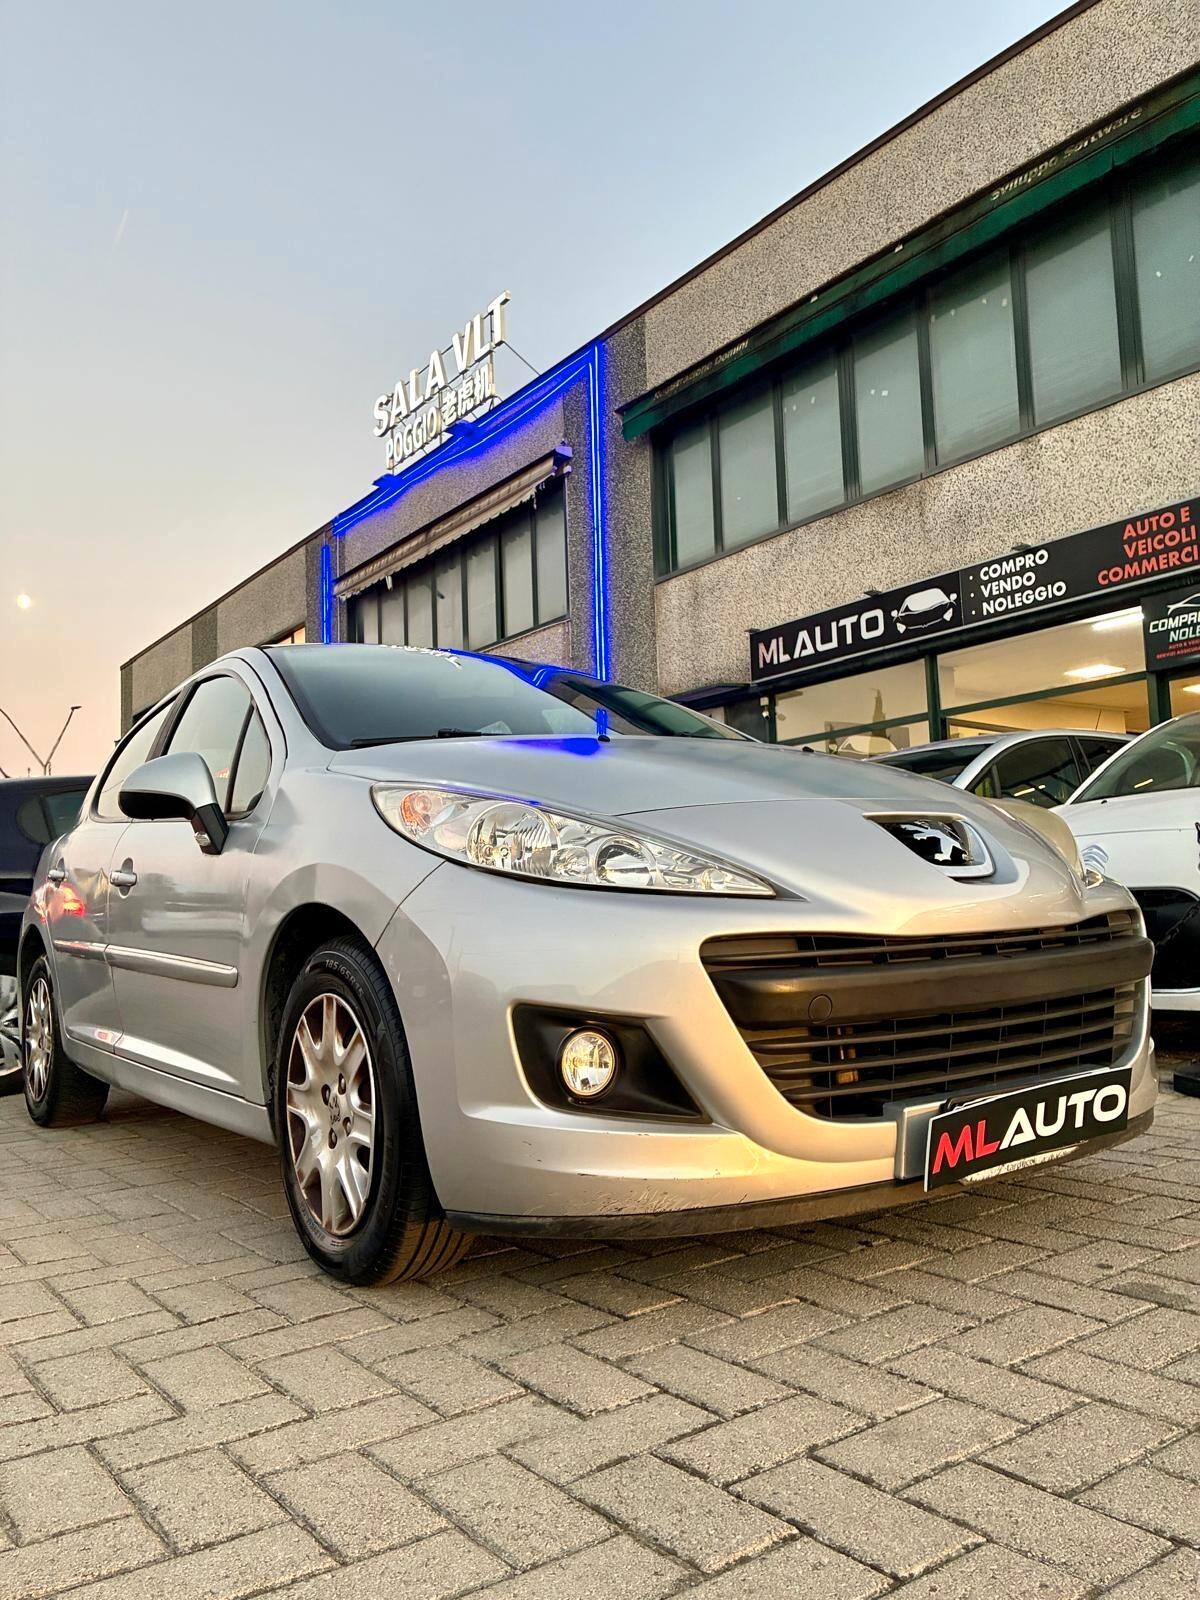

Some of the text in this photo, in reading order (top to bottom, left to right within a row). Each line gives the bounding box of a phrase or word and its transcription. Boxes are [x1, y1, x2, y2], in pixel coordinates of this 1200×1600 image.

[373, 289, 511, 437] SALA VLT
[441, 363, 492, 426] 老虎机
[386, 406, 440, 464] POGGIO
[1123, 506, 1190, 540] AUTO E
[1123, 525, 1196, 559] VEICOLI
[980, 549, 1048, 580] COMPRO
[1097, 544, 1199, 585] COMMERCI
[980, 571, 1036, 597] VENDO
[982, 581, 1066, 616] NOLEGGIO
[1149, 612, 1200, 633] COMPR
